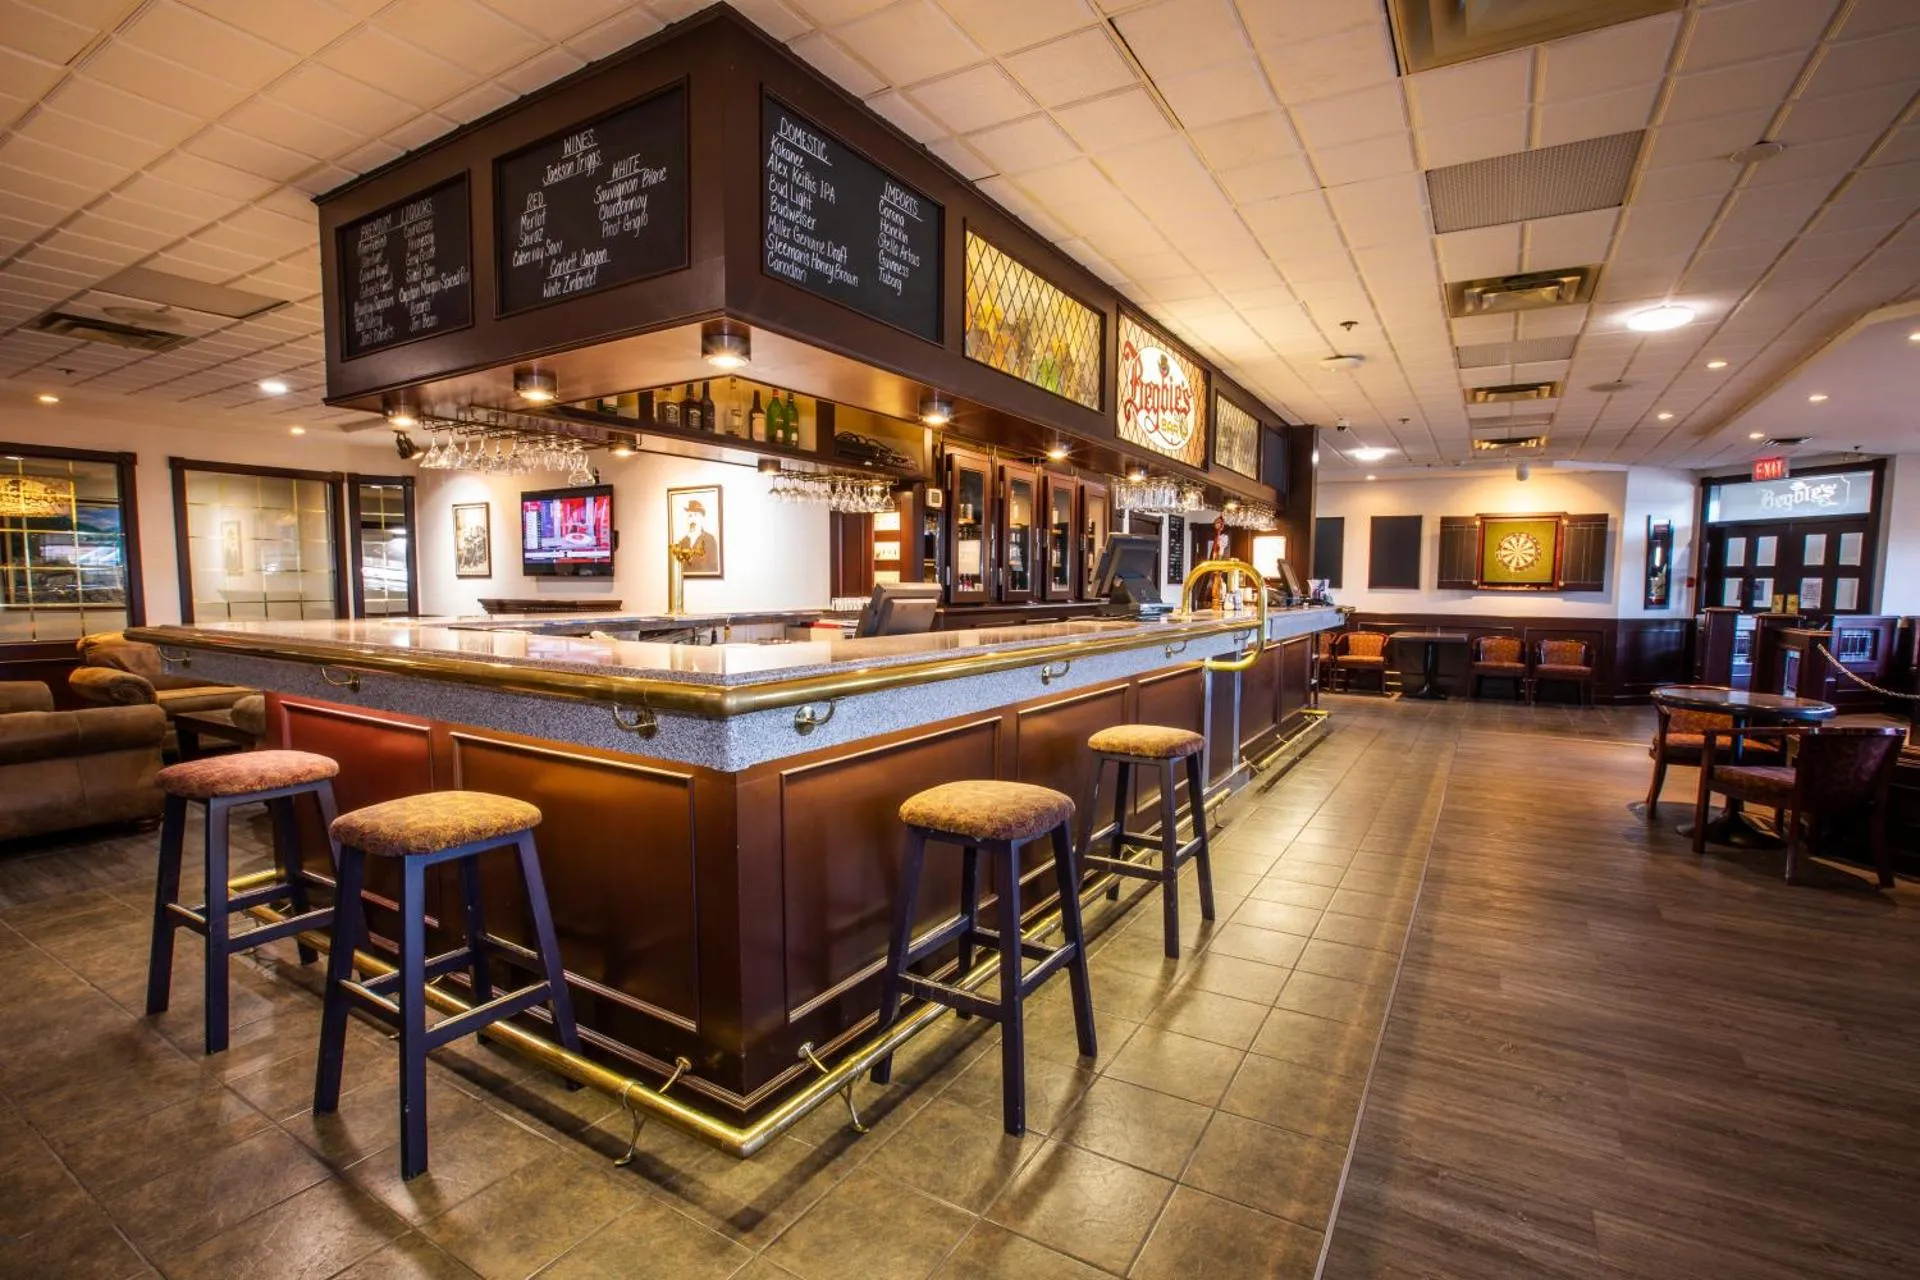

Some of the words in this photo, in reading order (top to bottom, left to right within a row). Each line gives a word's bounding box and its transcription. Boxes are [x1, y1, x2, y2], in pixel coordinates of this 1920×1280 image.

[563, 128, 595, 154] WINES
[770, 134, 805, 168] Kokanee
[780, 117, 829, 161] DOMESTIC
[612, 153, 641, 178] WHITE
[767, 154, 788, 179] Alex
[820, 180, 836, 204] IPA
[526, 191, 544, 210] RED
[769, 174, 788, 199] Bud
[790, 183, 813, 212] Light
[884, 181, 921, 216] IMPORTS
[520, 210, 546, 234] Merlot
[770, 195, 817, 231] Budweiser
[878, 200, 905, 227] Corona
[519, 228, 544, 248] Shiraz
[767, 215, 791, 240] Miller
[833, 261, 859, 288] Brown
[1755, 460, 1782, 479] EXIT
